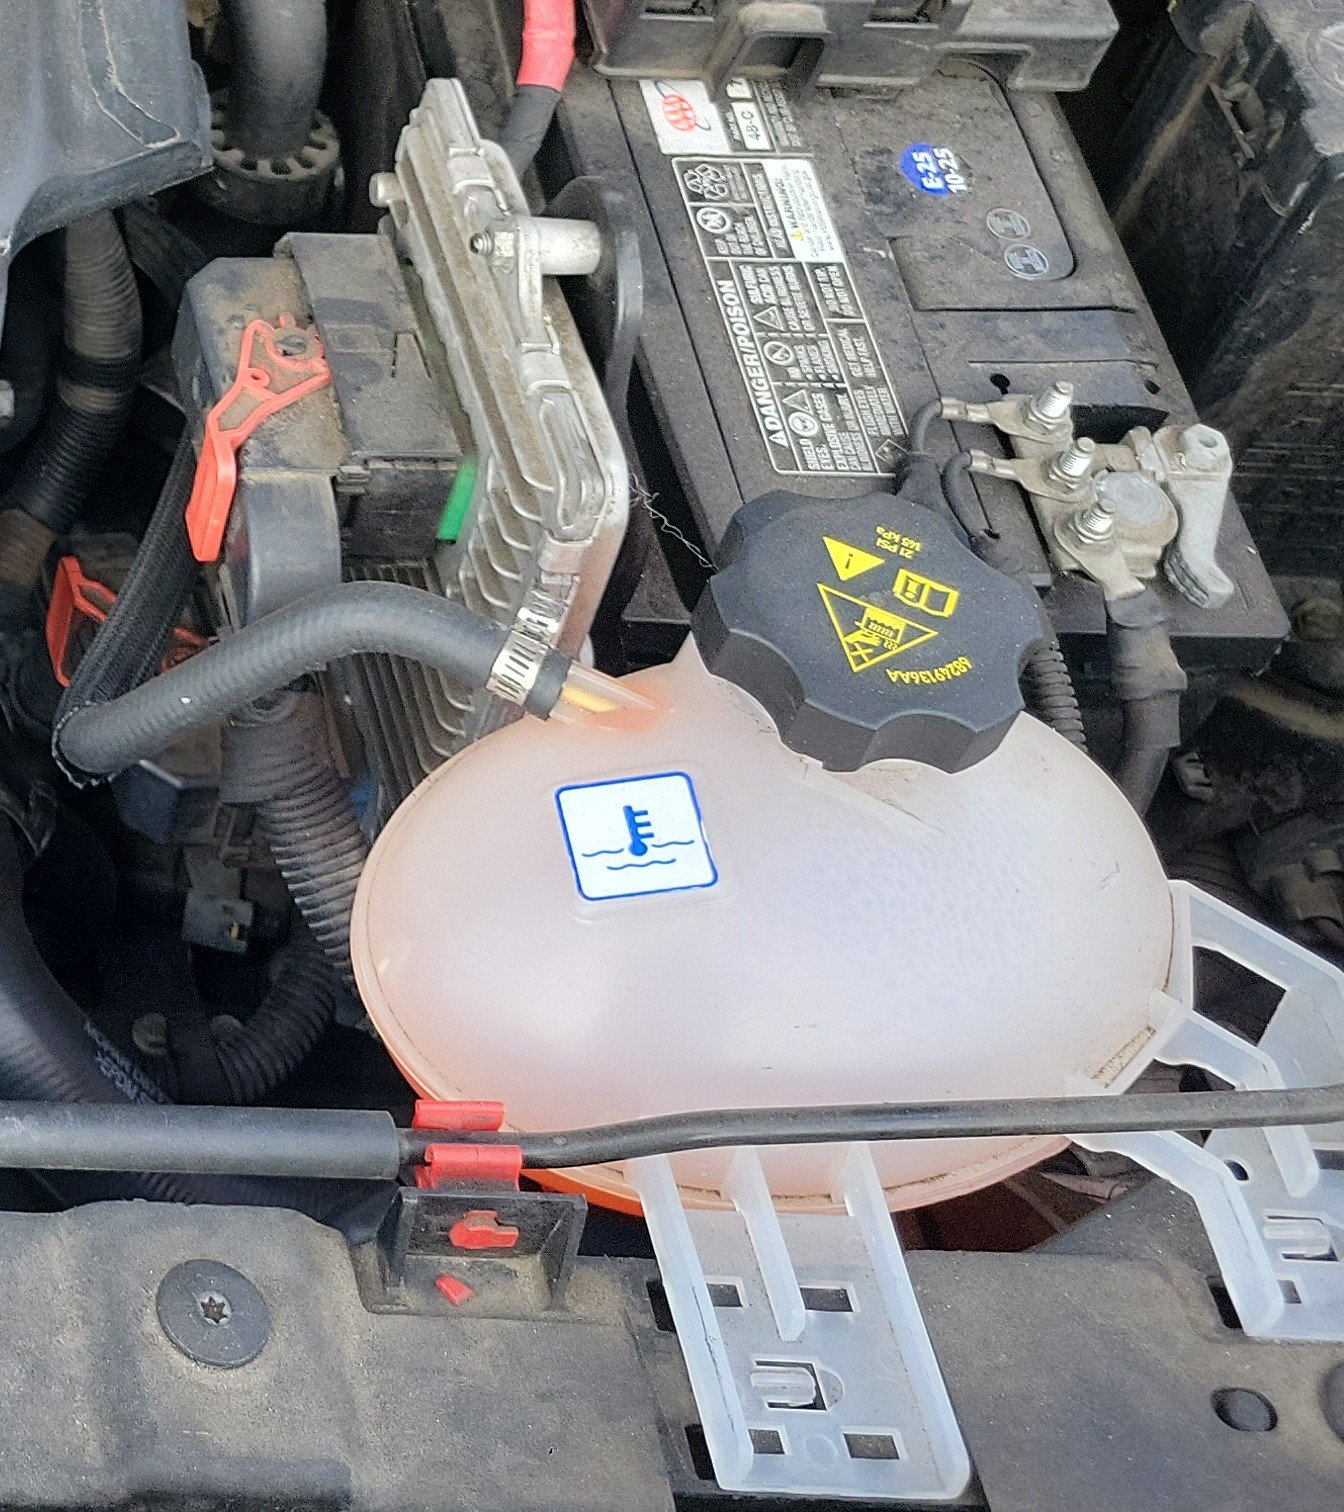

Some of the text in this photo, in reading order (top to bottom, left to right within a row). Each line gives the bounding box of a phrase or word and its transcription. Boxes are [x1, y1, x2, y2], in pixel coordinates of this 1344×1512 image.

[911, 150, 943, 192] E-25
[933, 147, 968, 194] 10-25
[738, 264, 763, 304] SULFURIC
[754, 267, 776, 302] ACID CAN
[768, 265, 800, 330] CAUSE BLINDNESS
[781, 265, 814, 330] OR SEVERE BURNS
[819, 283, 834, 297] NOT
[835, 289, 849, 302] NOT
[825, 298, 839, 311] DO
[840, 303, 854, 315] DO
[715, 280, 783, 430] DANGER/POISON
[793, 344, 813, 373] SPARKS
[806, 344, 826, 373] FLAMES
[817, 340, 839, 373] SMOKING
[836, 328, 863, 376] GET MEDICAL
[859, 356, 876, 376] HELP
[853, 389, 878, 435] FLUSH EYES
[864, 384, 891, 435] IMMEDIATELY
[811, 393, 849, 469] EXPLOSIVE GASES
[799, 438, 820, 469] SHIELD
[837, 432, 861, 469] CAN CAUSE
[849, 432, 872, 470] BLINDNESS
[875, 526, 899, 544] kPa
[875, 537, 914, 559] 21 PSI
[885, 655, 973, 685] 68249136AA
